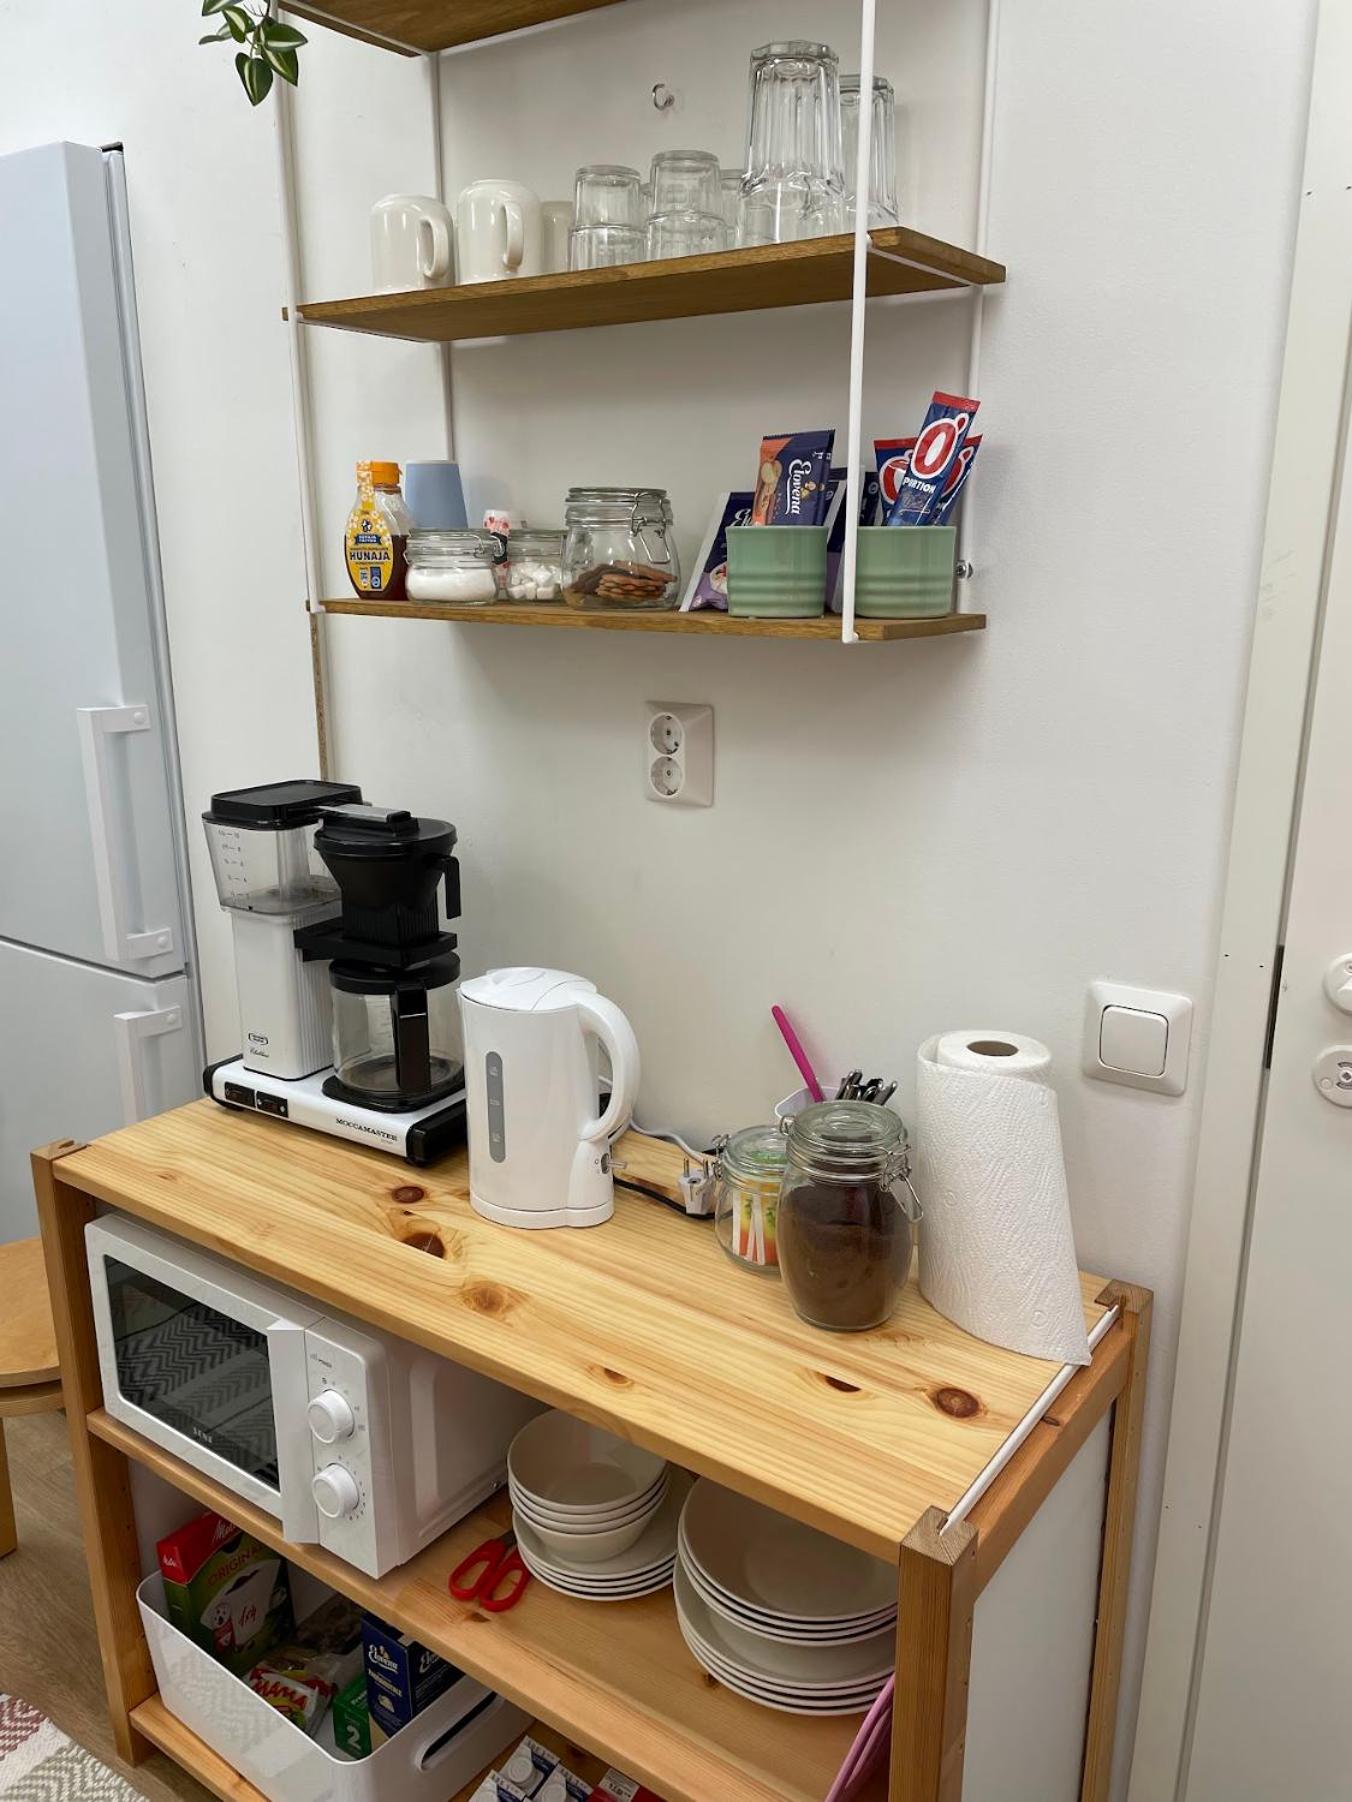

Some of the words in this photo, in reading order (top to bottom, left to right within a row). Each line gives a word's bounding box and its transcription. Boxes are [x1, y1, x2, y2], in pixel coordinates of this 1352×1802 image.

[785, 459, 812, 515] Elovena
[350, 551, 390, 561] HUNAJA
[335, 1118, 398, 1141] MOCCAMASTER
[346, 1724, 363, 1750] 2
